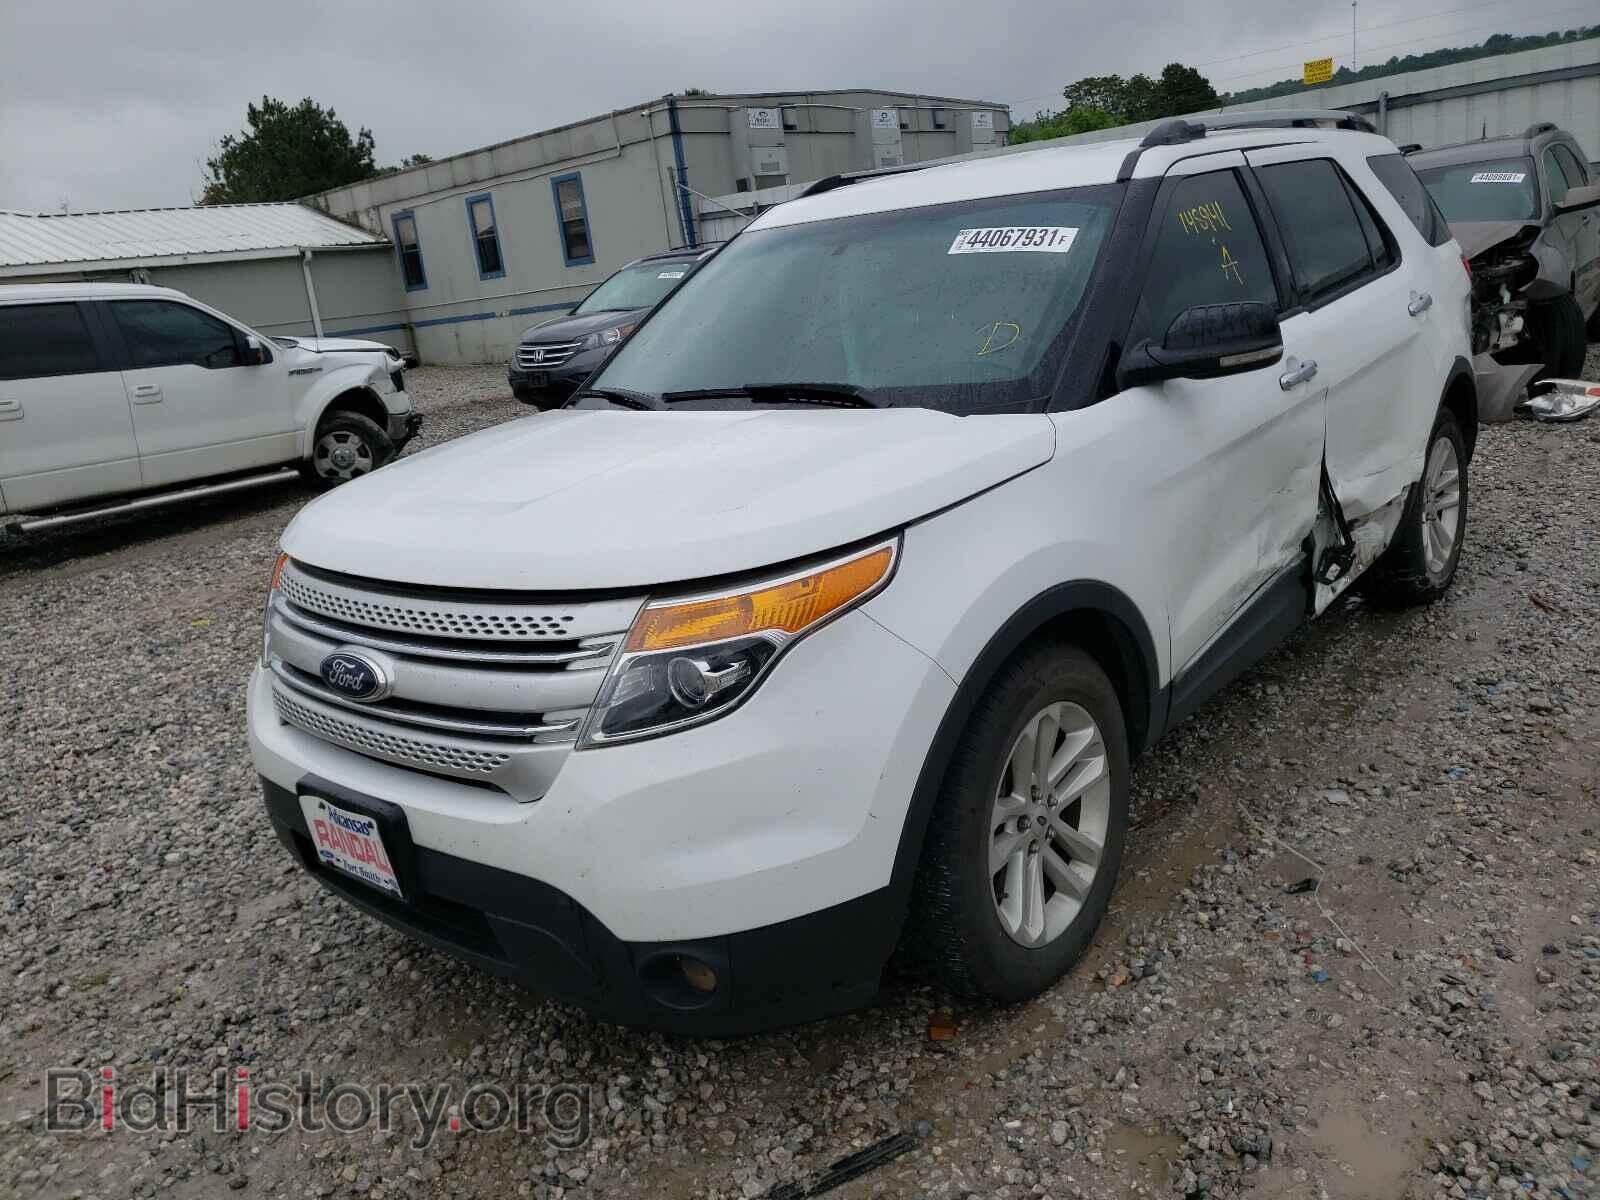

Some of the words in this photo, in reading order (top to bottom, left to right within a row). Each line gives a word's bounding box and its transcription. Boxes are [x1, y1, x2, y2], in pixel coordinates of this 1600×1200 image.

[966, 228, 1058, 248] 44067931
[1221, 246, 1244, 285] A
[976, 322, 1020, 357] D
[329, 659, 365, 690] Ford
[327, 806, 371, 836] Arkansas
